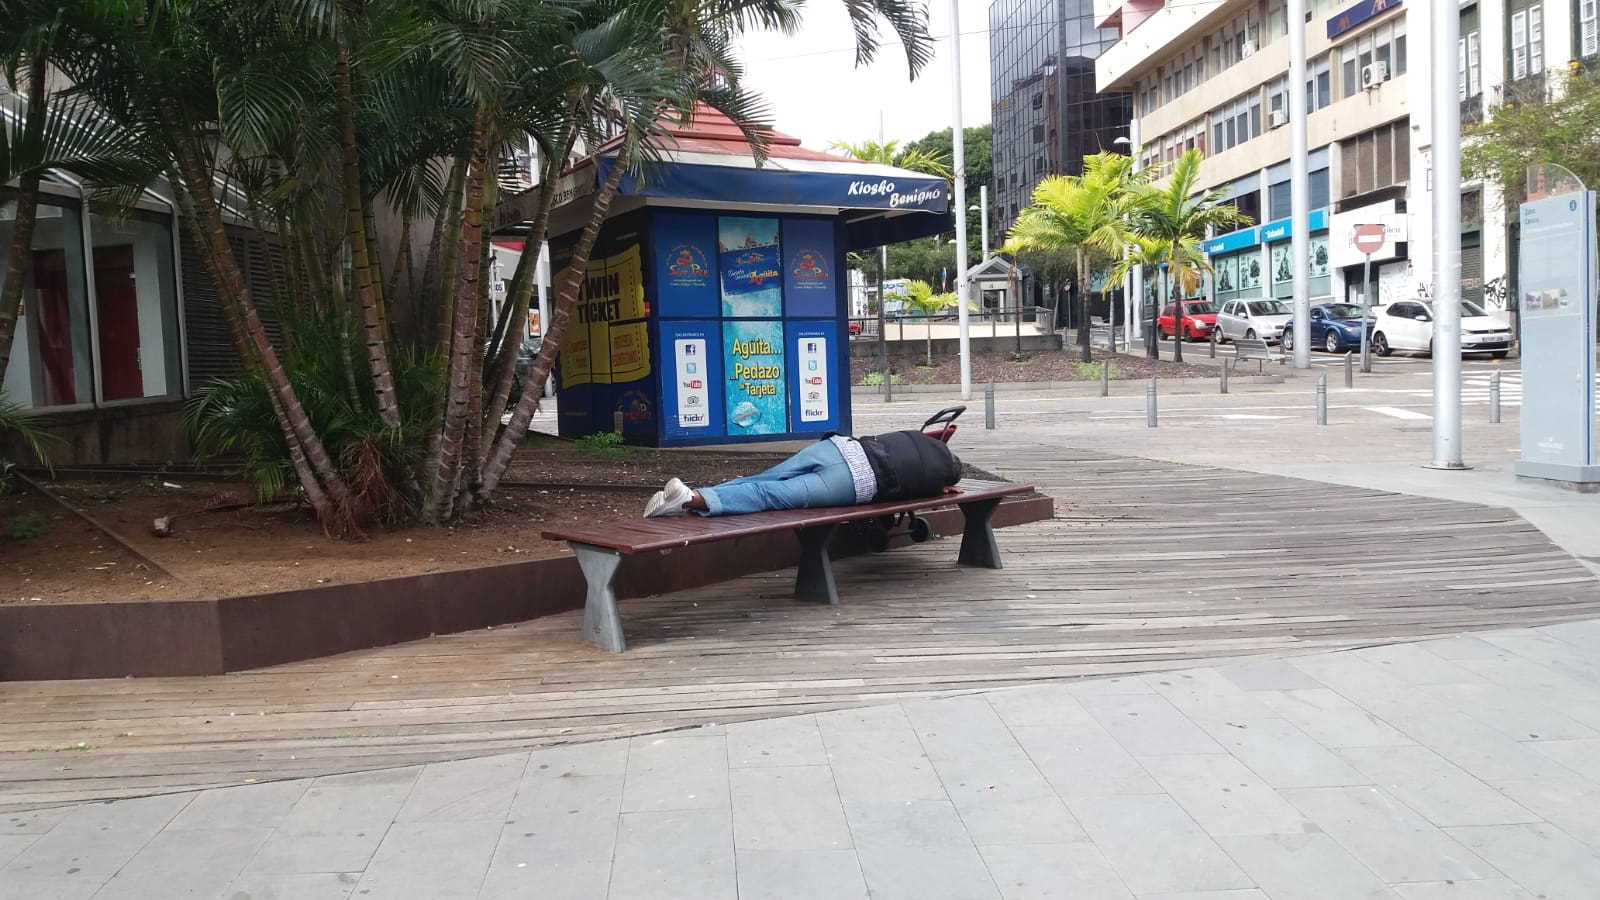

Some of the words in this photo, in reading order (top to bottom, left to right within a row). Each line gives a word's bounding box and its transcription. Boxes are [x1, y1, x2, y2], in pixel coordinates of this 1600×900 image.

[848, 180, 895, 196] Kiosko
[889, 188, 941, 208] Benigno
[577, 299, 621, 323] TICKET
[744, 382, 776, 398] Tarjeta
